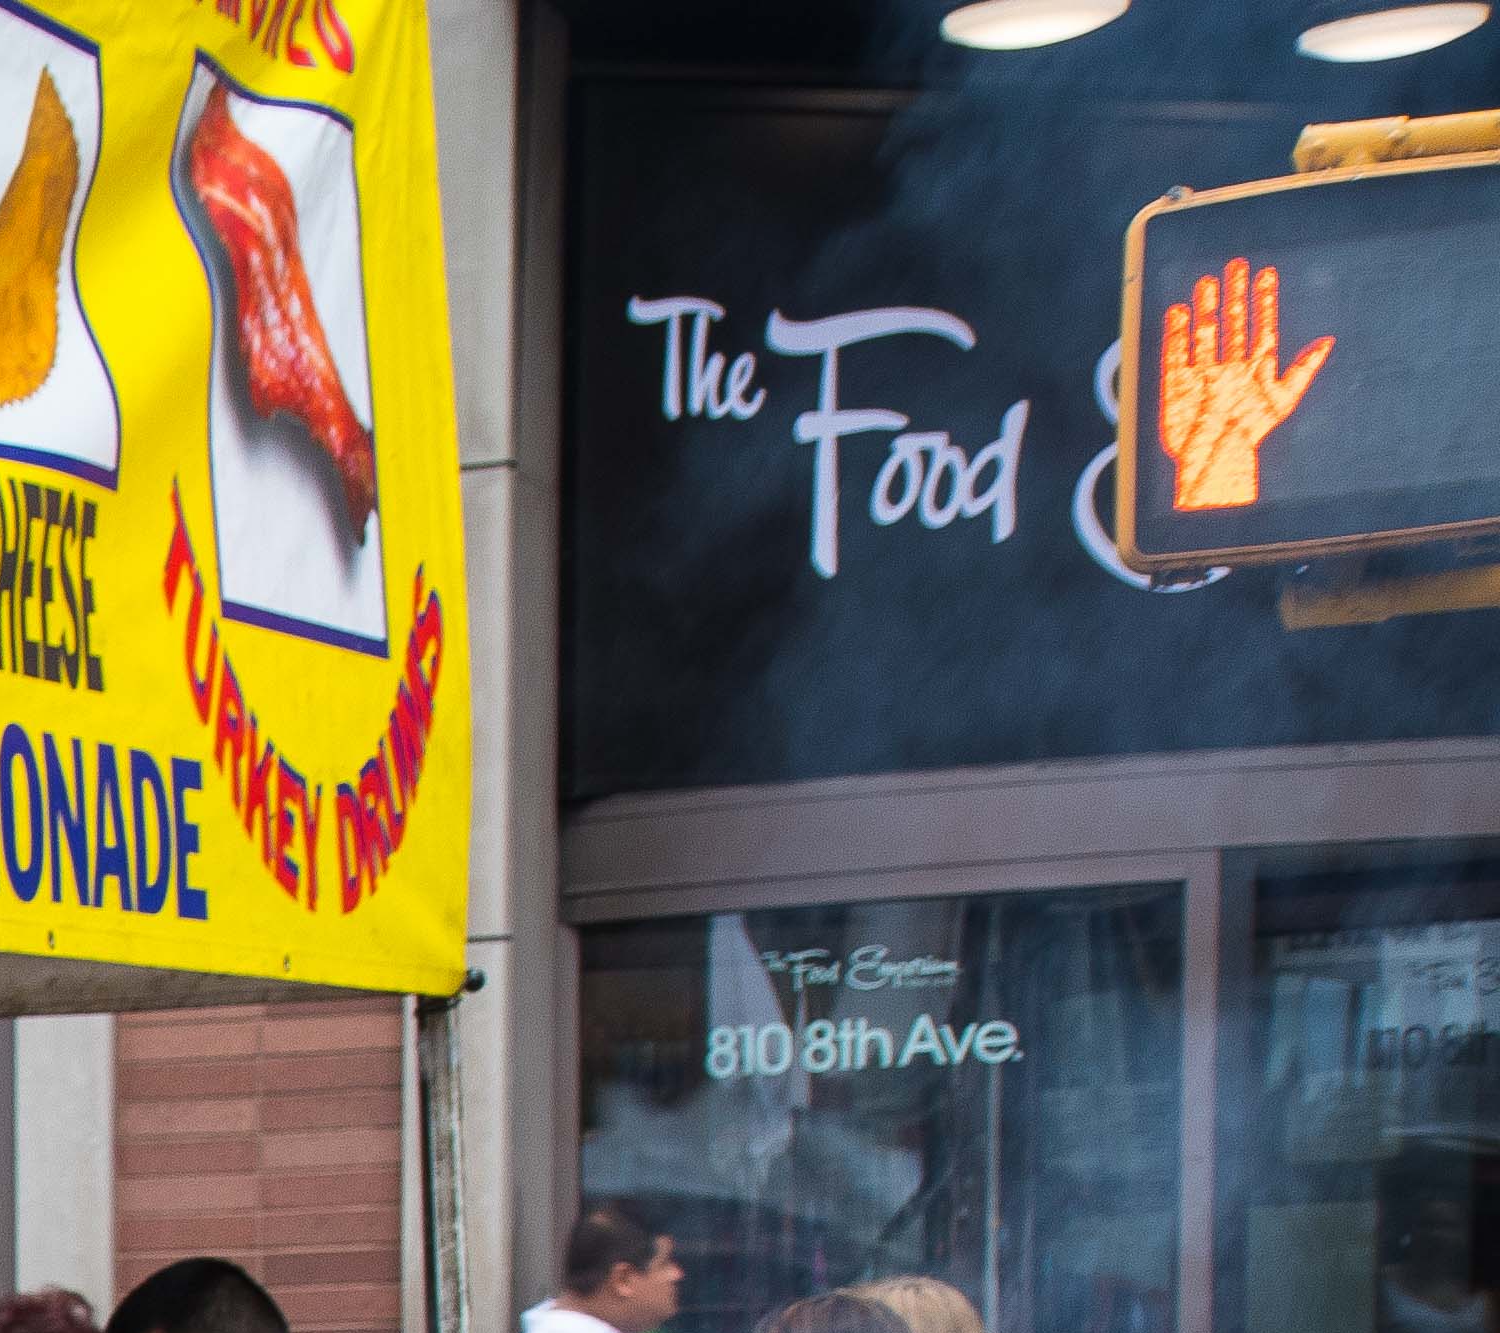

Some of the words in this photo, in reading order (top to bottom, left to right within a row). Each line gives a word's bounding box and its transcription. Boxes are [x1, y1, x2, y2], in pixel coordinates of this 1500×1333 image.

[628, 296, 767, 420] The
[766, 306, 1030, 578] Food
[162, 477, 320, 910] TURKEY
[338, 561, 445, 914] DRUMS
[704, 1022, 795, 1080] 810
[802, 1017, 896, 1074] 8th
[898, 1012, 1025, 1066] Ave.
